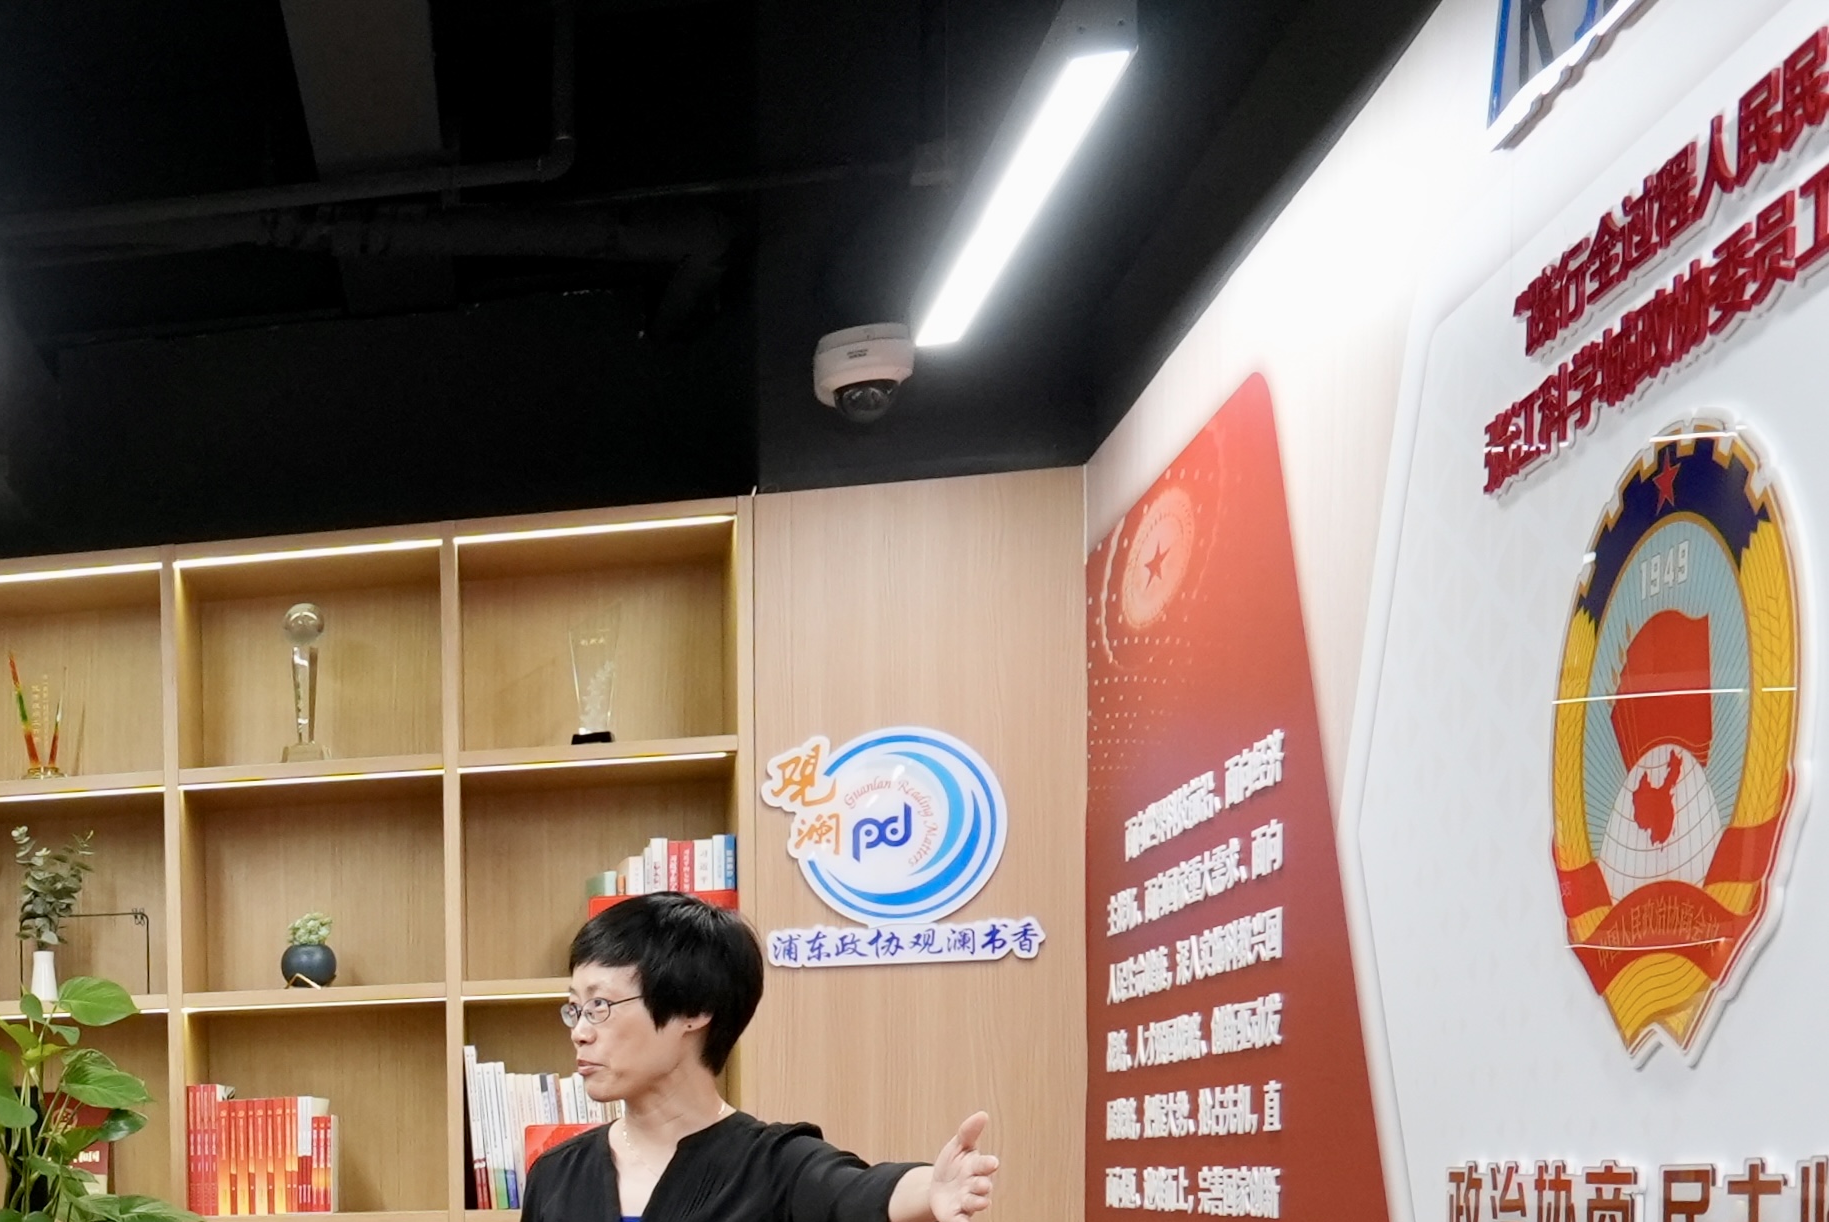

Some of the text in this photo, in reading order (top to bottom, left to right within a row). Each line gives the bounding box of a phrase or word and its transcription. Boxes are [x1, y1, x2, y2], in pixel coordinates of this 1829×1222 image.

[1639, 540, 1689, 600] 1949
[772, 923, 1039, 962] 浦东政协观澜书香
